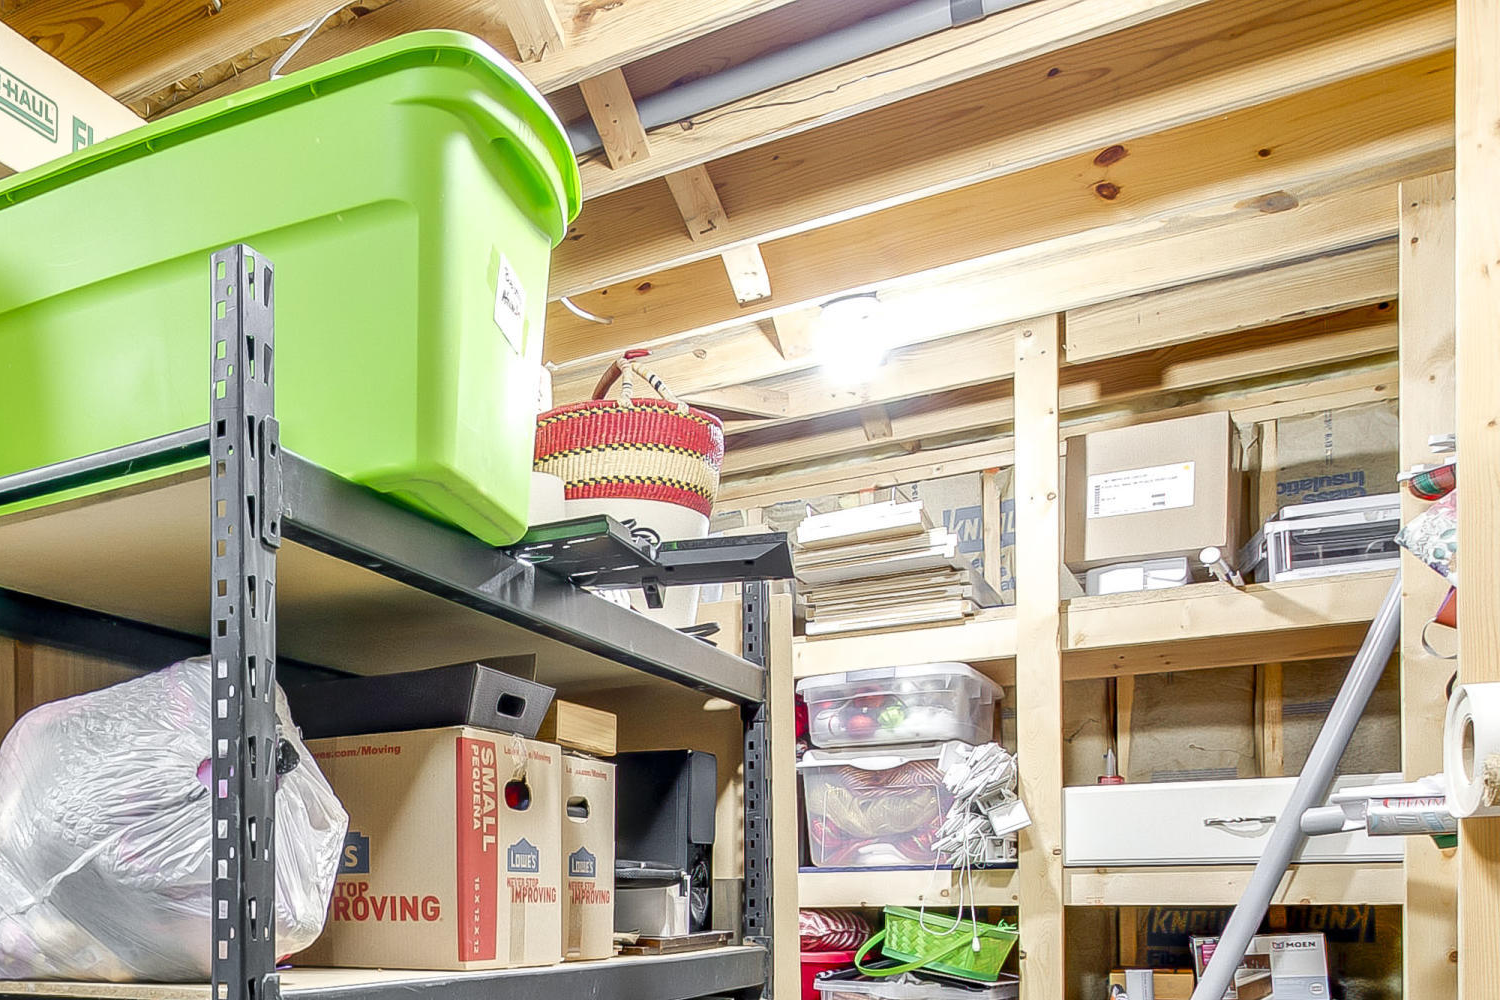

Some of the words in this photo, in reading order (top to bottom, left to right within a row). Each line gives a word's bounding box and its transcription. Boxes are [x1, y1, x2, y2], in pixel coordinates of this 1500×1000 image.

[481, 746, 497, 853] SMALL
[333, 881, 369, 898] TOP
[506, 877, 524, 888] NEVER
[525, 877, 539, 888] STOP
[511, 886, 557, 904] IMPROVING
[571, 888, 610, 905] IMPROVING
[333, 895, 441, 922] ROVING
[1285, 941, 1317, 949] MOEN
